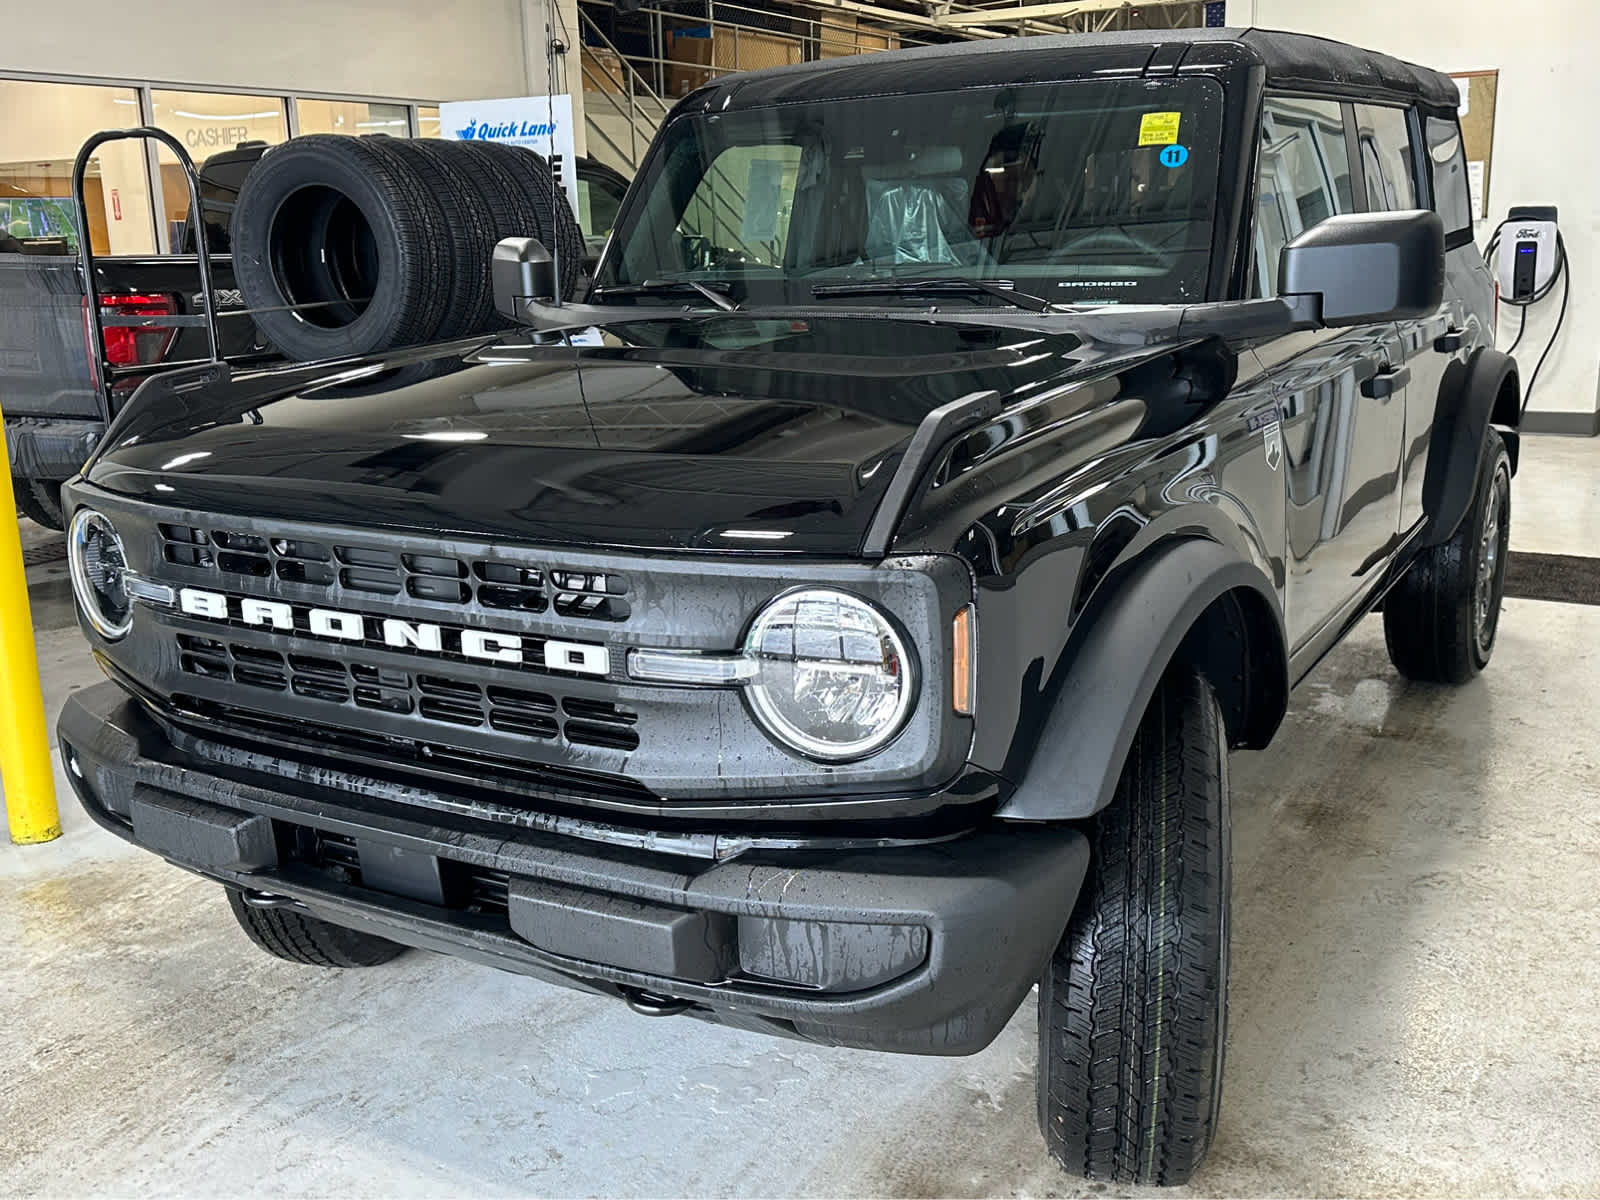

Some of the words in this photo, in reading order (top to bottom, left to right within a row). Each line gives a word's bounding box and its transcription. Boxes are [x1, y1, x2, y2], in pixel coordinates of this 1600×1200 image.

[185, 126, 249, 147] CASHIER
[478, 121, 518, 141] Quick
[520, 121, 556, 137] Lane
[1165, 150, 1180, 163] 11
[1516, 228, 1540, 239] Ford
[180, 588, 610, 676] BRONCO
